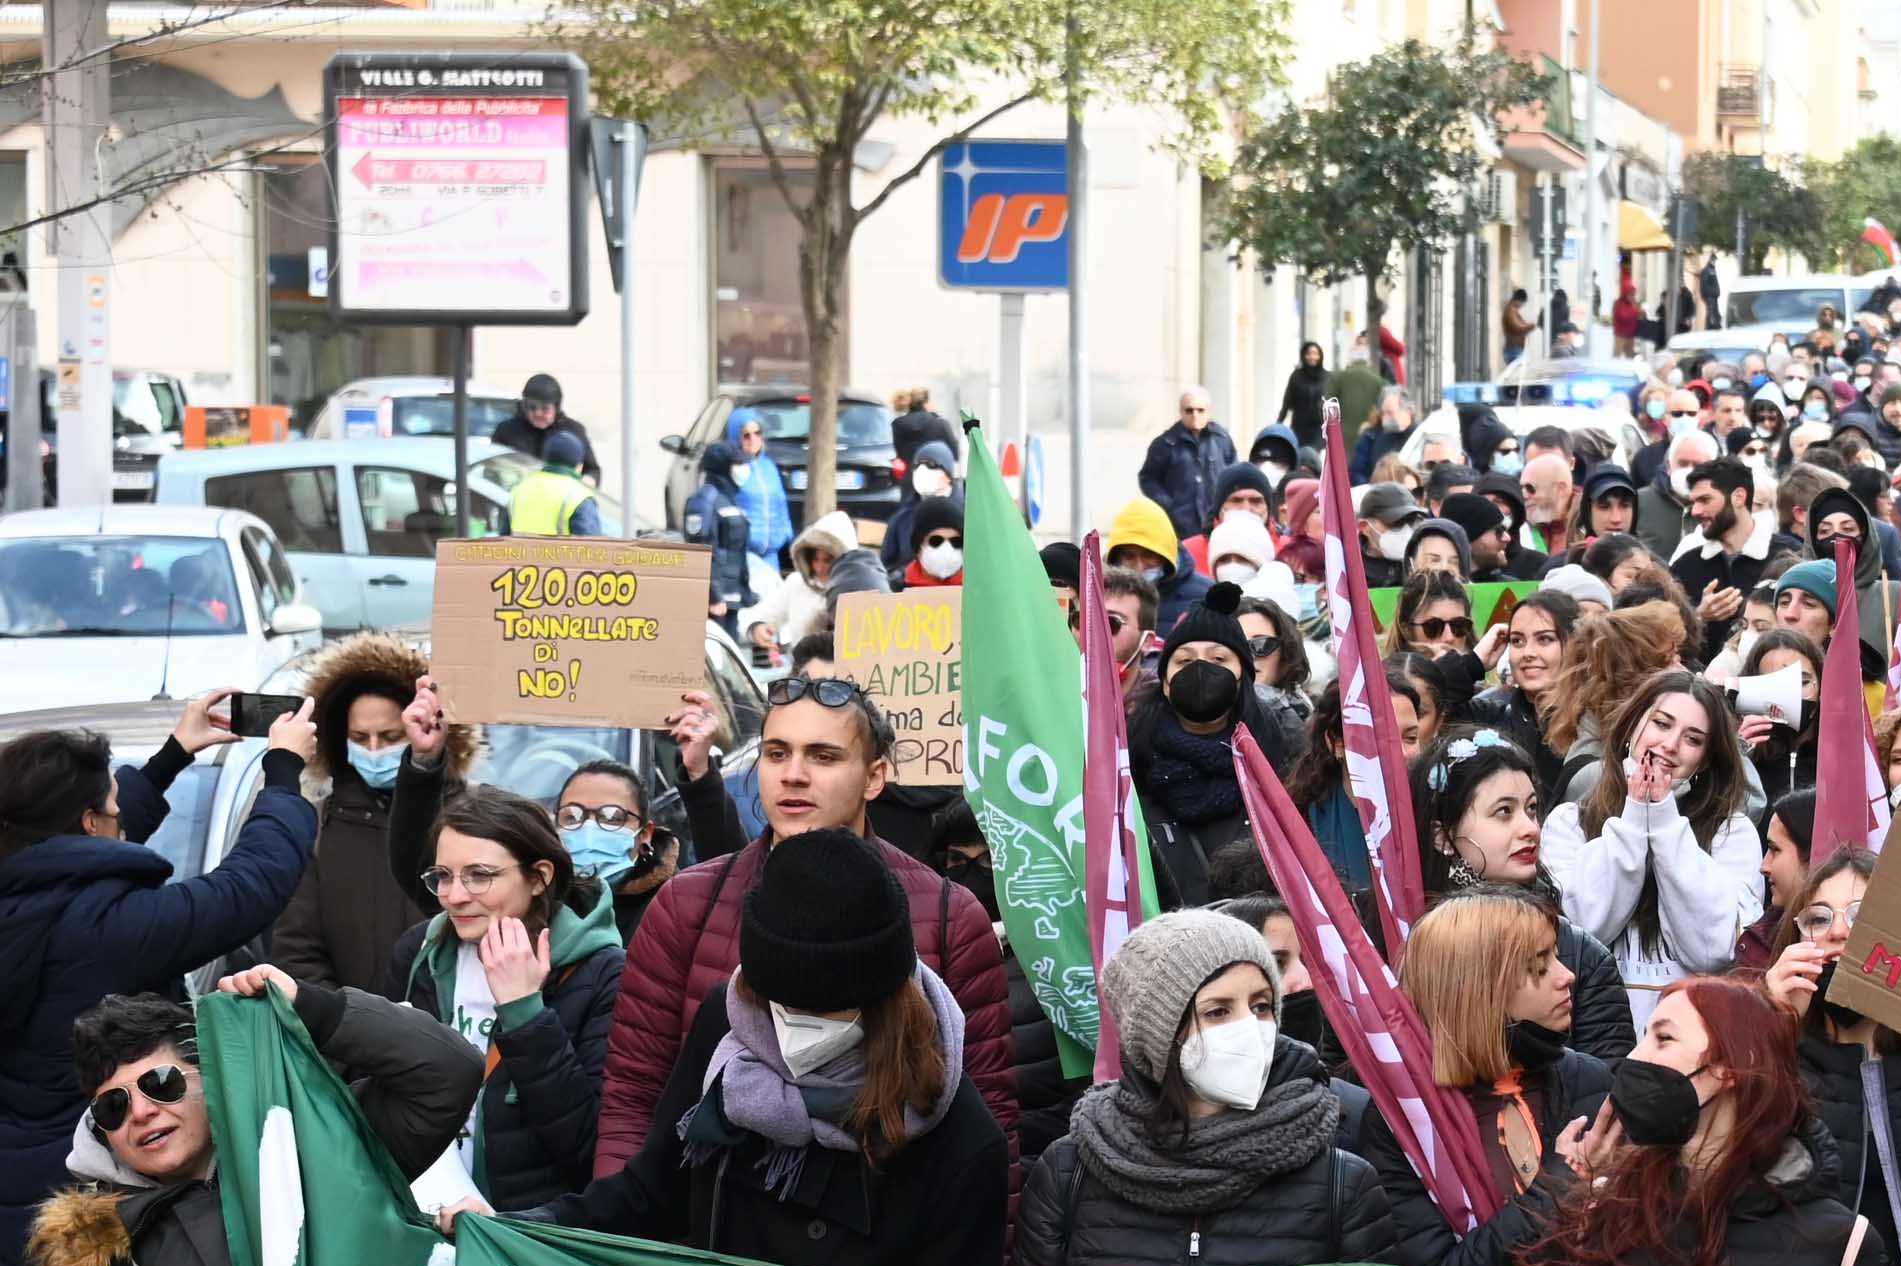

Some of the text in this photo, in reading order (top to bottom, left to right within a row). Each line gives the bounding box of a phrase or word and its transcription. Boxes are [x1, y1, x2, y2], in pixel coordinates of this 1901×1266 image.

[956, 191, 1069, 263] IP
[490, 564, 638, 609] 120.000
[517, 658, 583, 703] NO!
